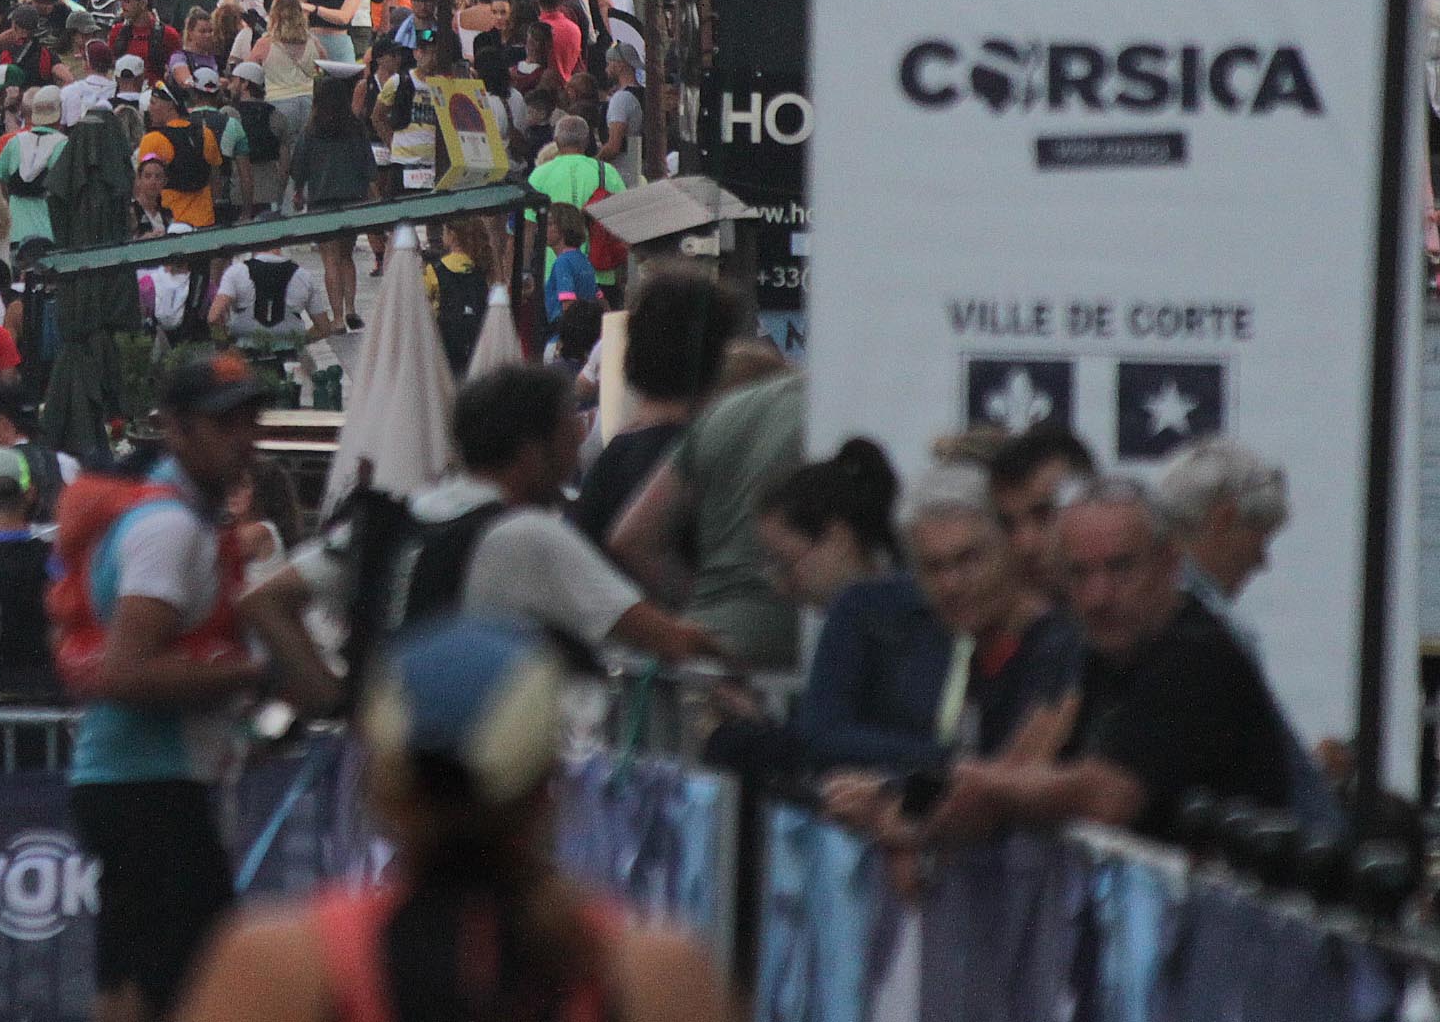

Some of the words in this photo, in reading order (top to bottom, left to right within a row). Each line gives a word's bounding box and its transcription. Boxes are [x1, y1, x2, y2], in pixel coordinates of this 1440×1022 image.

[946, 297, 1053, 337] VILLE
[1067, 299, 1114, 338] DE
[1128, 301, 1256, 339] CORTE
